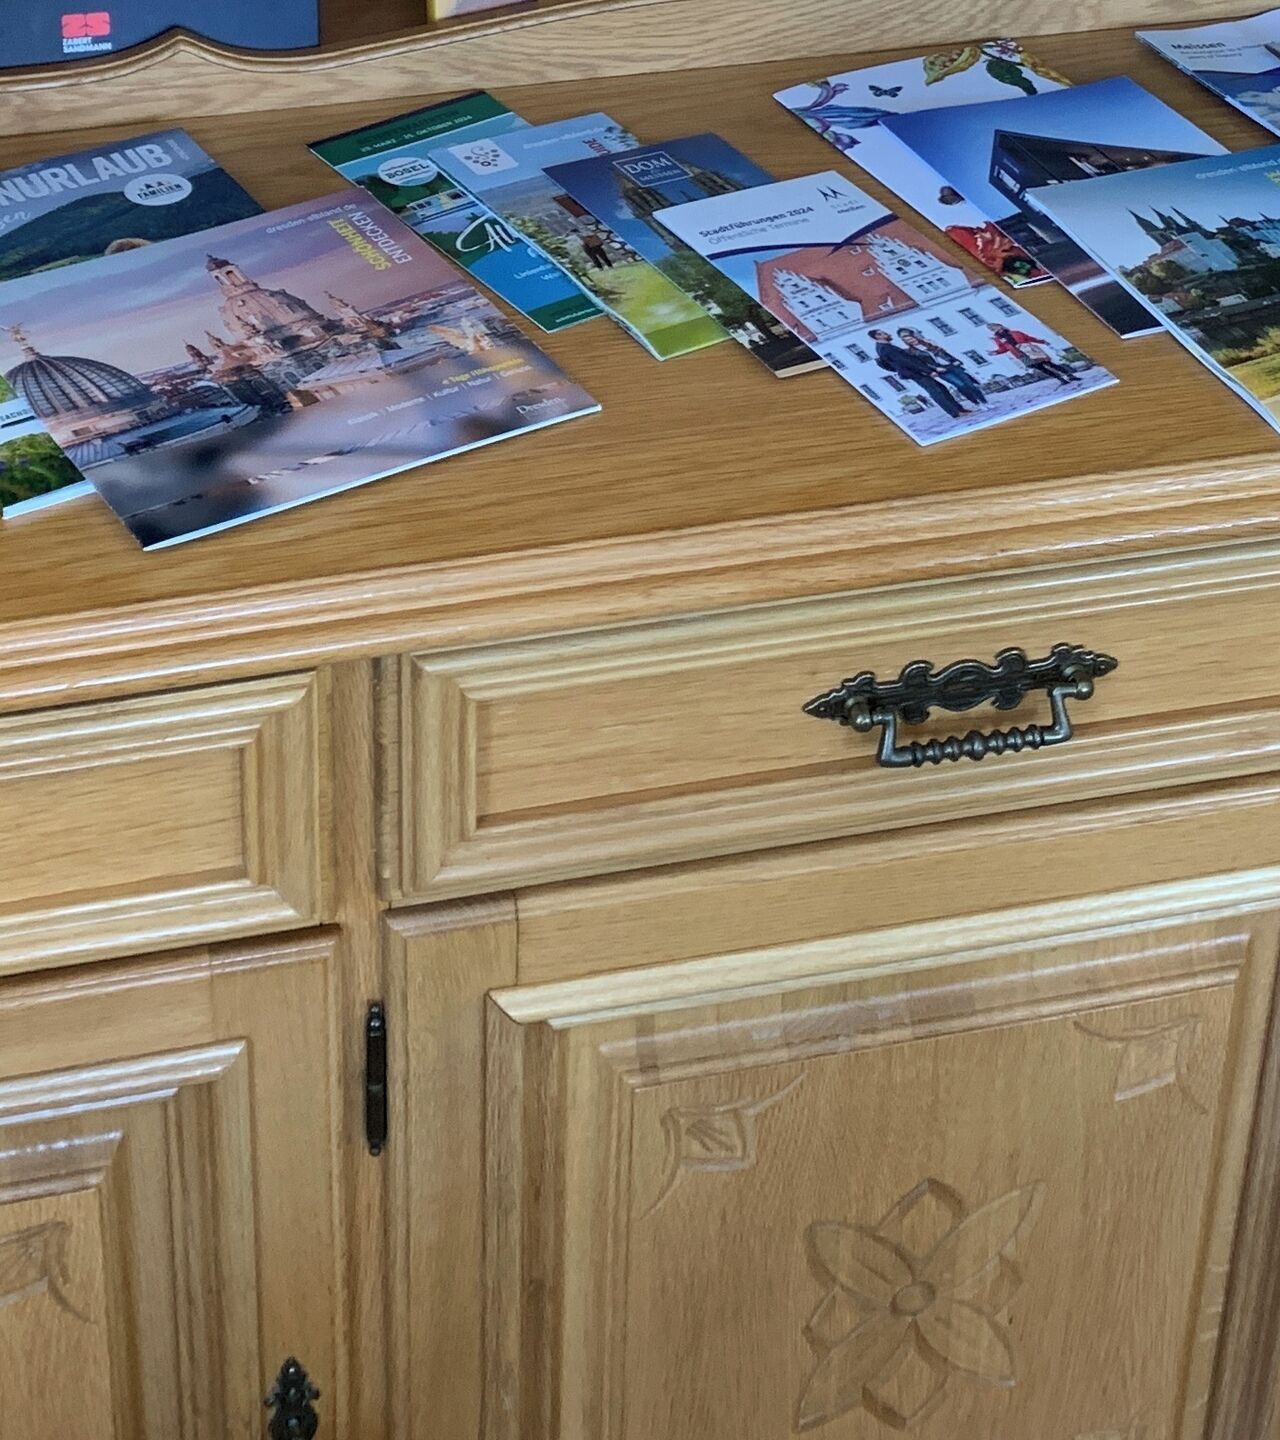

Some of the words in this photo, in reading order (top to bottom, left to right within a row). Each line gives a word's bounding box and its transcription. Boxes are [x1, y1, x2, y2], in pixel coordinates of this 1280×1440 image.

[63, 41, 112, 53] SANDMANN
[623, 159, 672, 175] DOM
[136, 182, 184, 200] FAMILIEN
[698, 214, 789, 239] Stadtführungen
[787, 205, 816, 219] 2024
[328, 218, 391, 271] SCHÖNHEIT
[348, 211, 413, 264] ENTDECKEN
